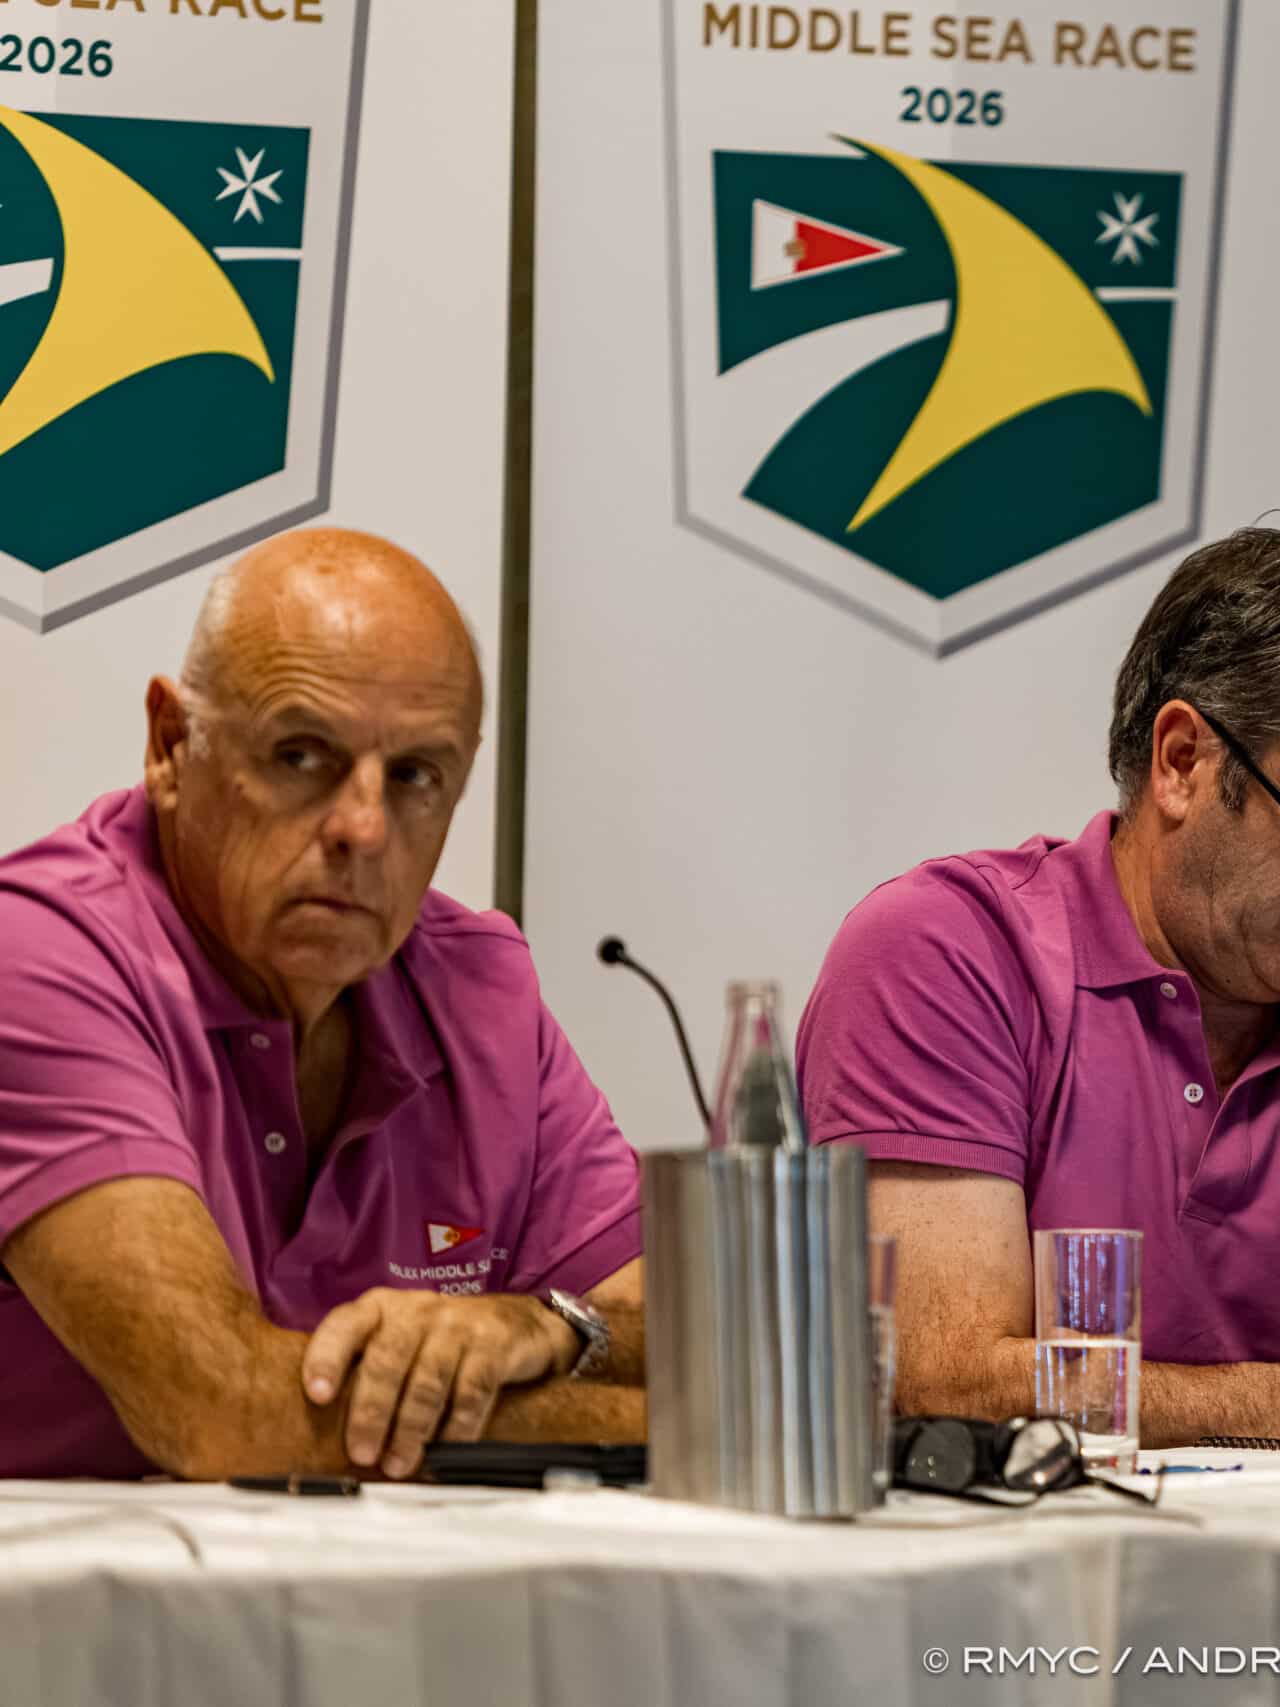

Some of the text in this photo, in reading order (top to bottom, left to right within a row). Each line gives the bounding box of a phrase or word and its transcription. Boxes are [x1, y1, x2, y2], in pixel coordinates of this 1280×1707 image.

[0, 34, 115, 79] 2026
[703, 3, 1198, 73] MIDDLE SEA RACE
[899, 85, 1006, 128] 2026
[420, 1262, 476, 1281] MIDDLE
[440, 1281, 481, 1296] 2026
